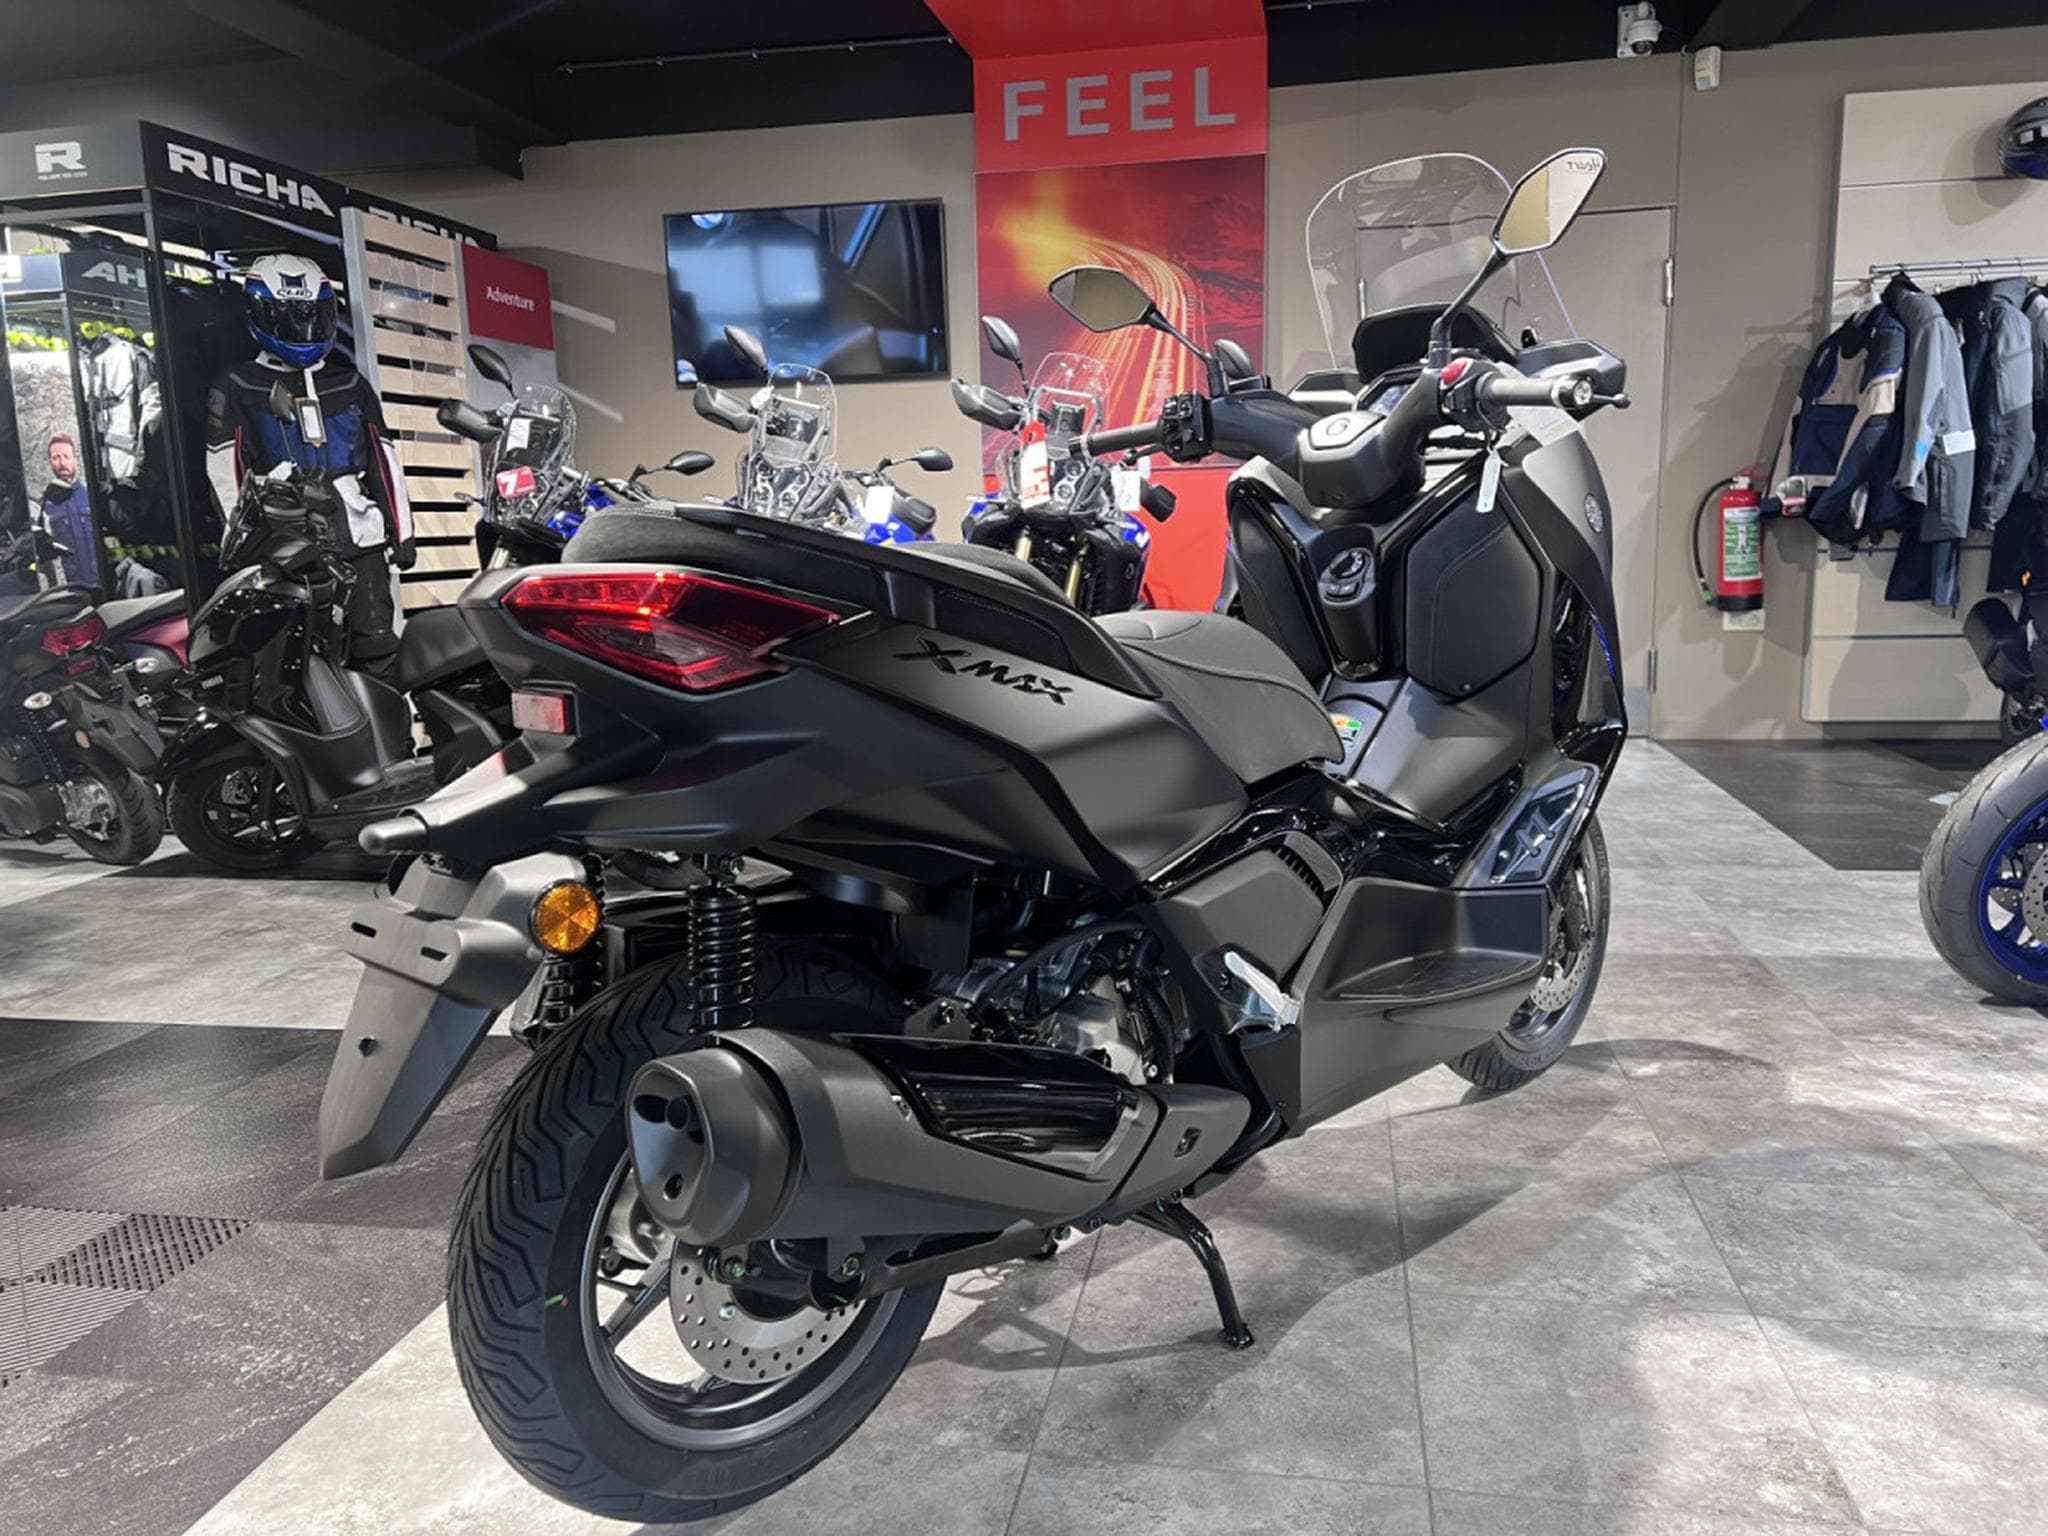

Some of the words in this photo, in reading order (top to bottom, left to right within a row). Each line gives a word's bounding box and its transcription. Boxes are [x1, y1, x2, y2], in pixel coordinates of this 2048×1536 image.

[1003, 66, 1236, 141] FEEL
[35, 141, 87, 173] R
[167, 142, 336, 219] RICHA
[486, 286, 535, 312] Adventure
[892, 637, 1074, 706] XMAX
